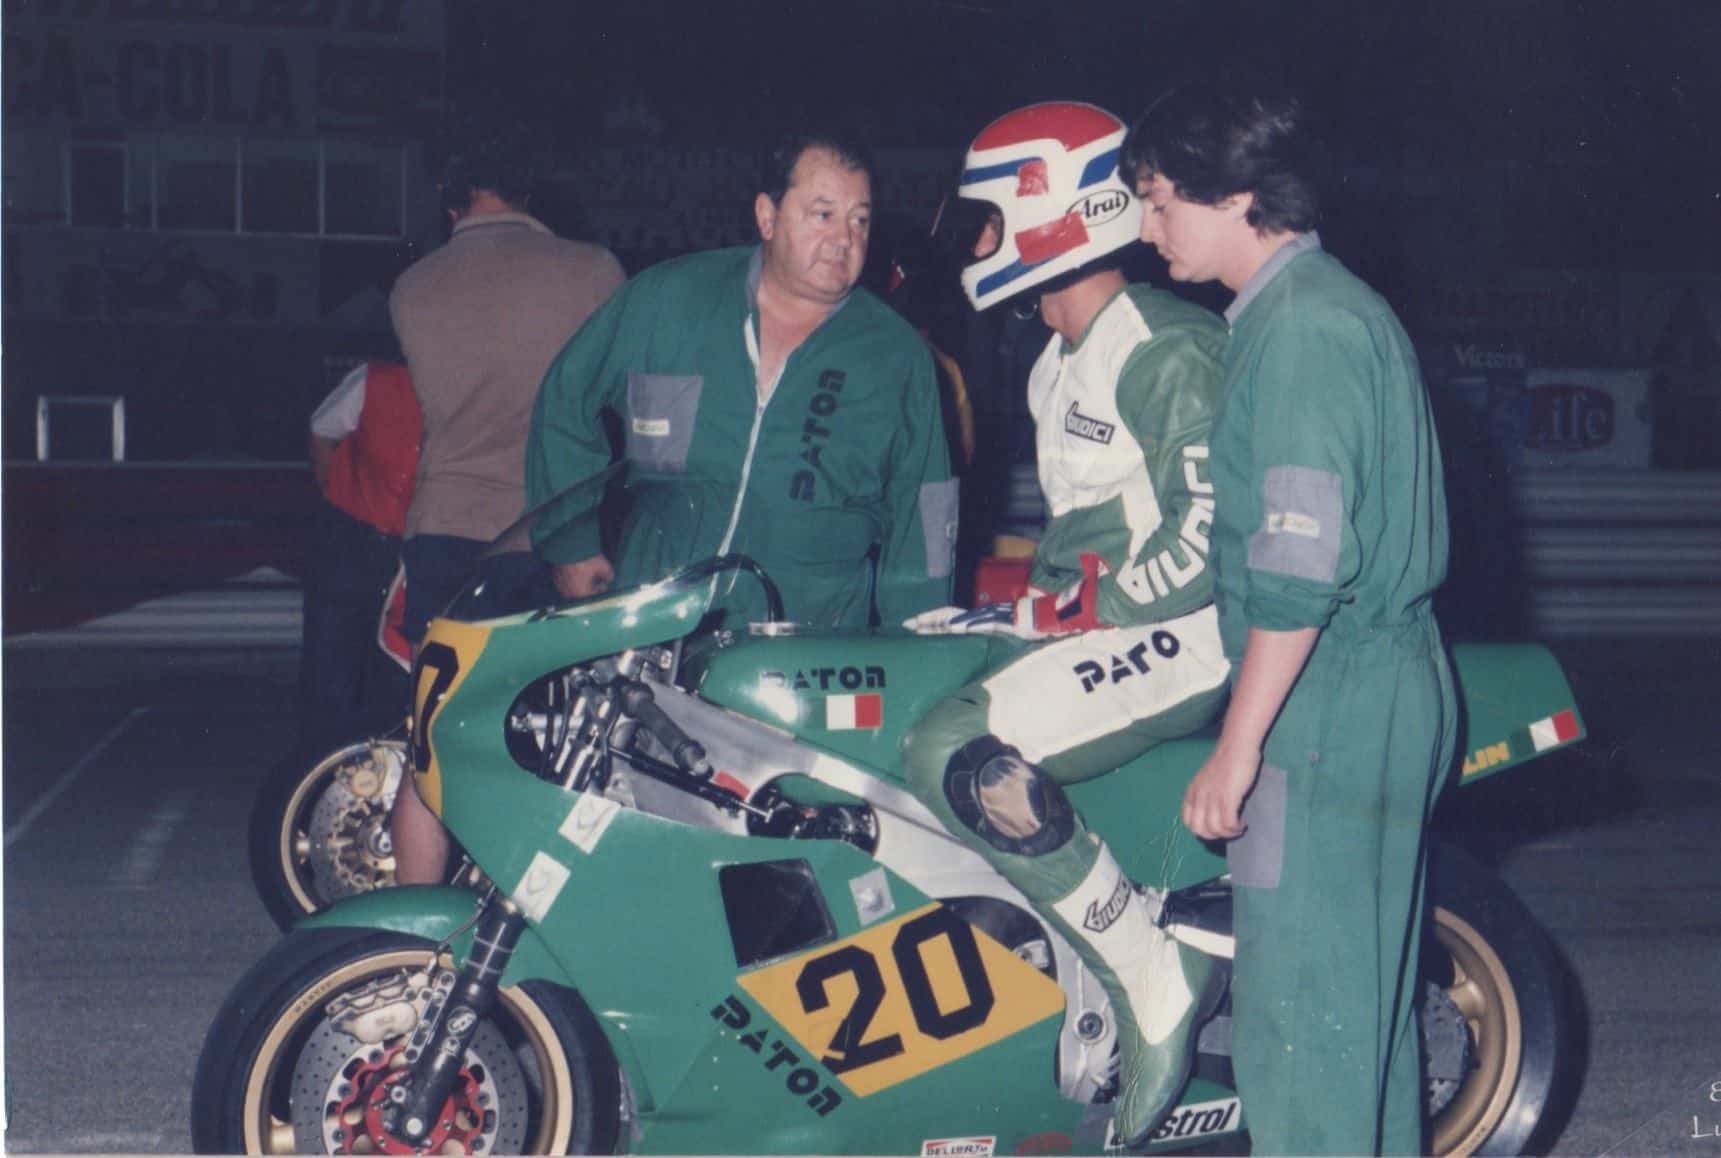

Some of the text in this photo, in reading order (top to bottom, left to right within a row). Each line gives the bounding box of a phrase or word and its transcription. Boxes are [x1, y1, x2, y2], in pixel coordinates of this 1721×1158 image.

[789, 368, 848, 501] PATON
[795, 902, 995, 1075] 20
[709, 994, 843, 1117] PATON
